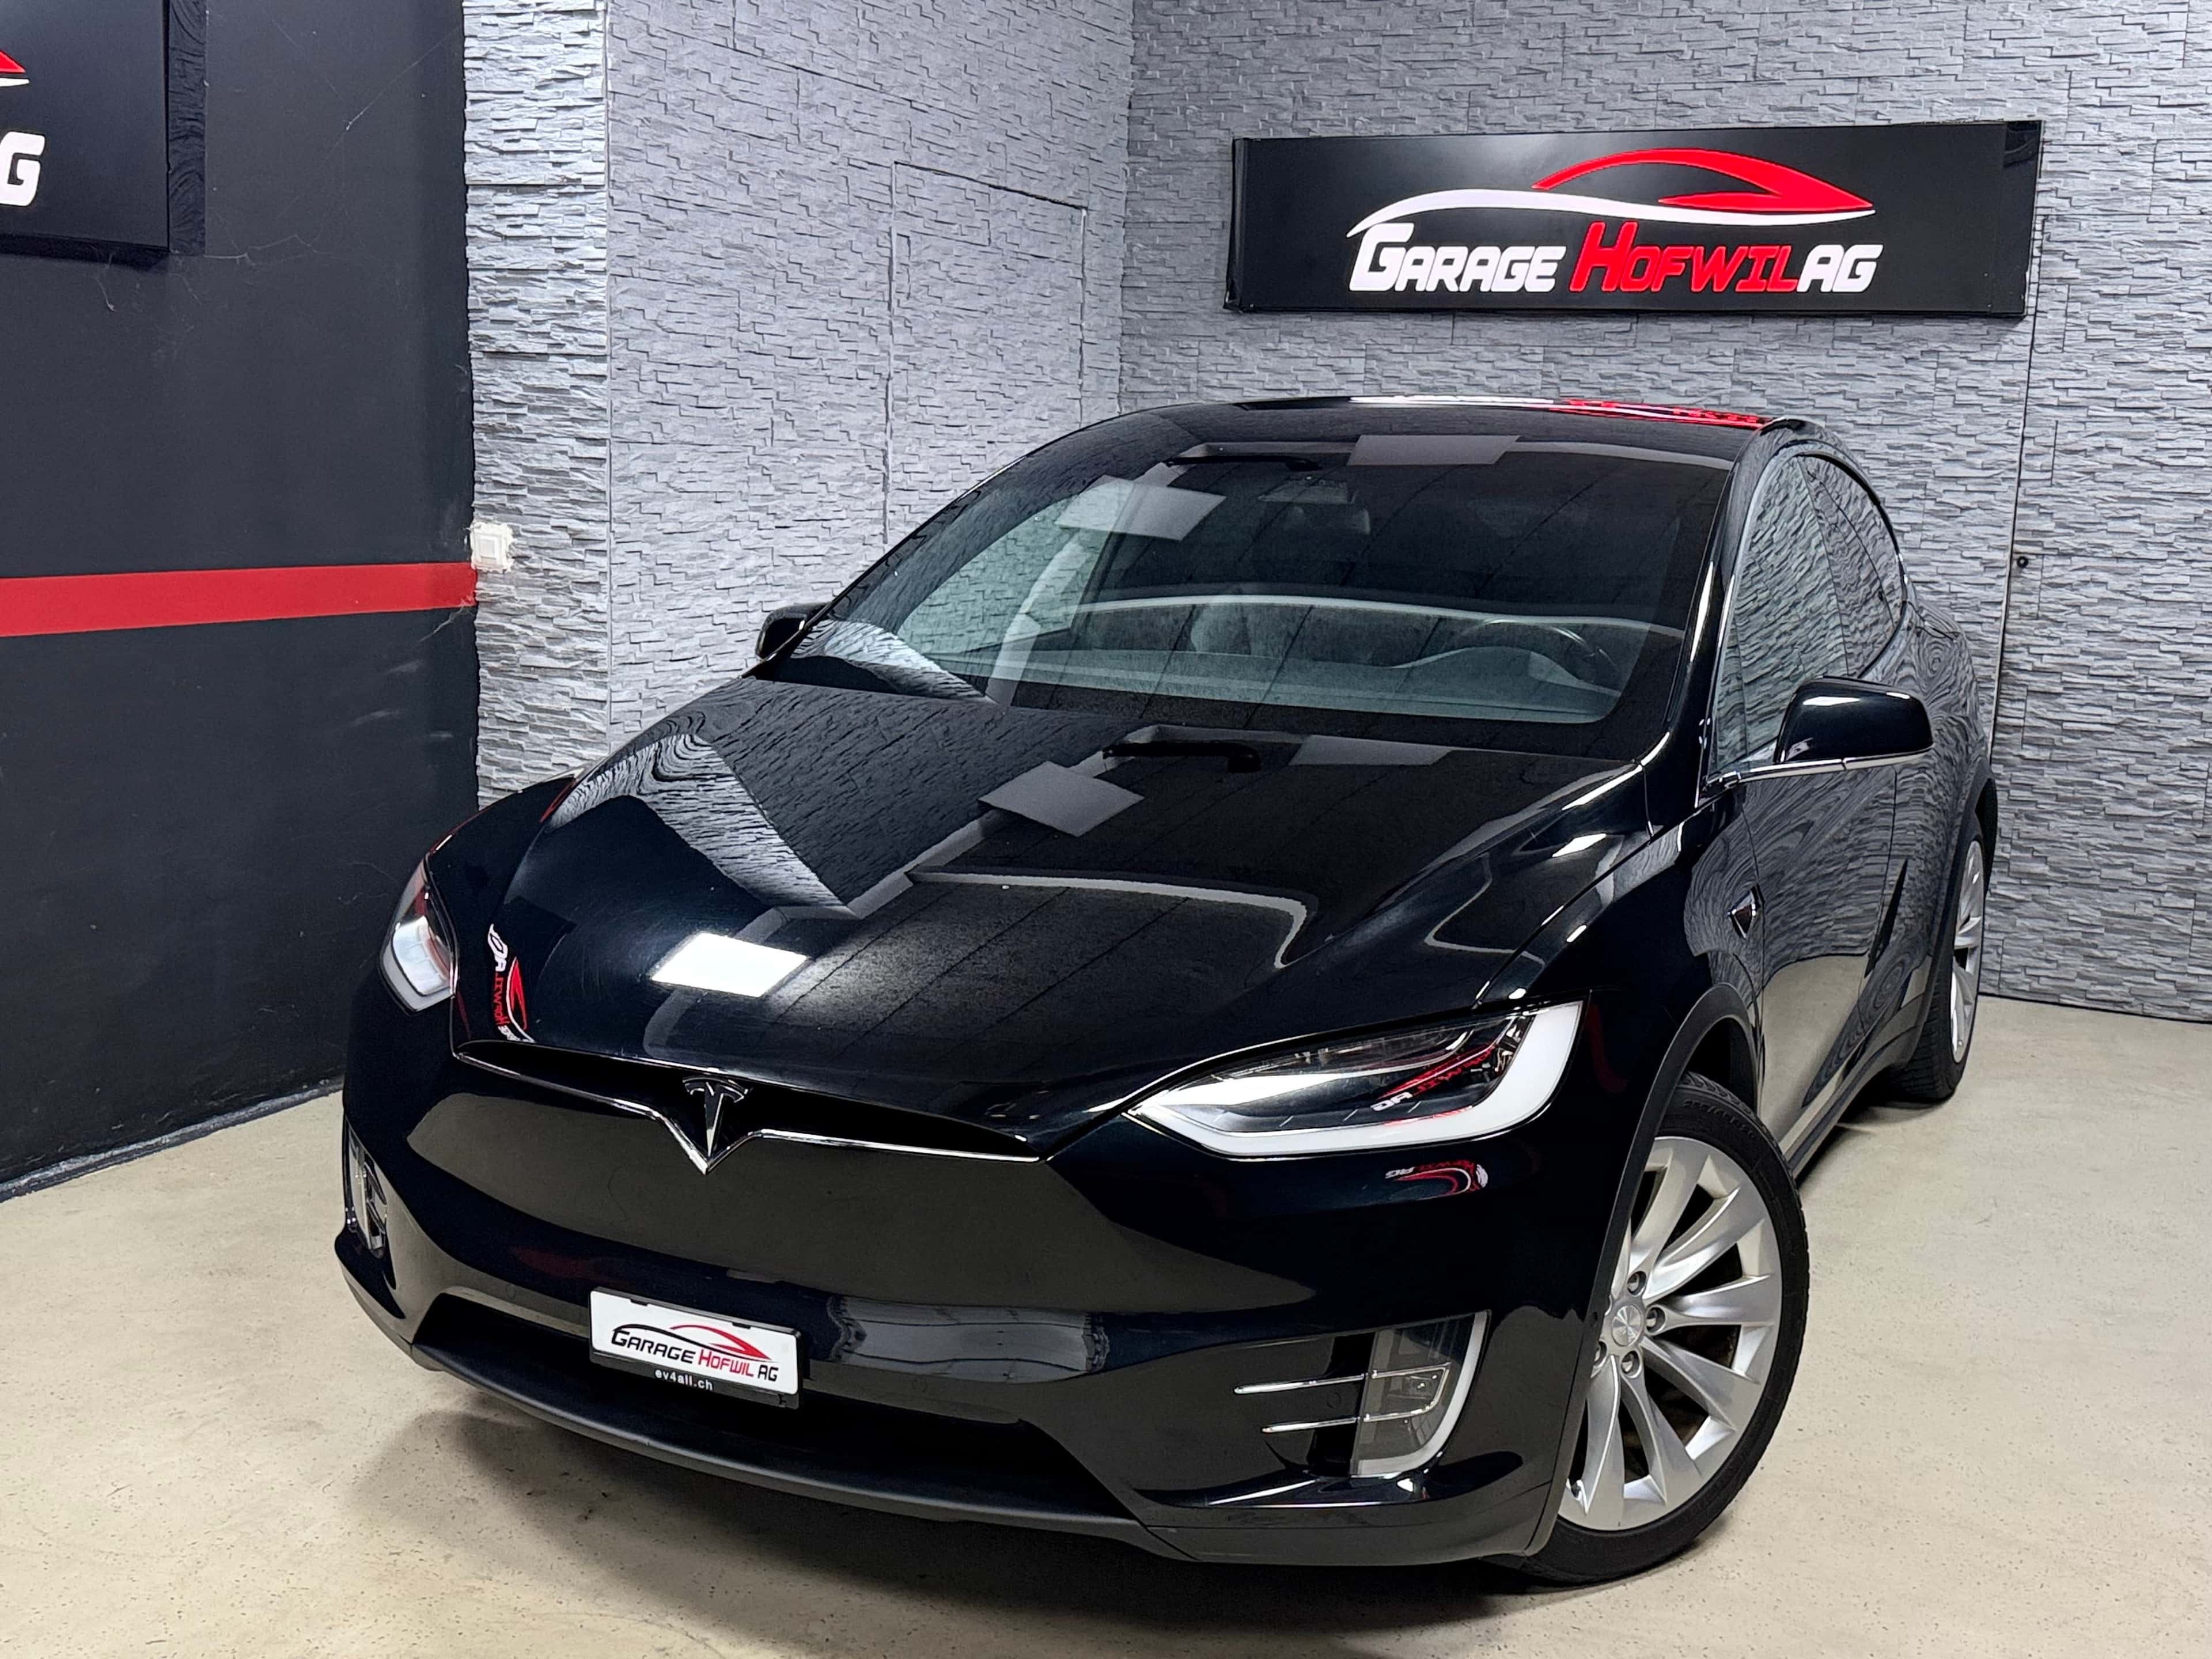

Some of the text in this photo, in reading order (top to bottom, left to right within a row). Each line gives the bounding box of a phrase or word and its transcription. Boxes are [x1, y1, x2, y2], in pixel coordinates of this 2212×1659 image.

[1349, 223, 1566, 293] GARAGE
[611, 1330, 779, 1382] GARAGE HOFWIL AG
[655, 1368, 714, 1391] ev4all.ch
